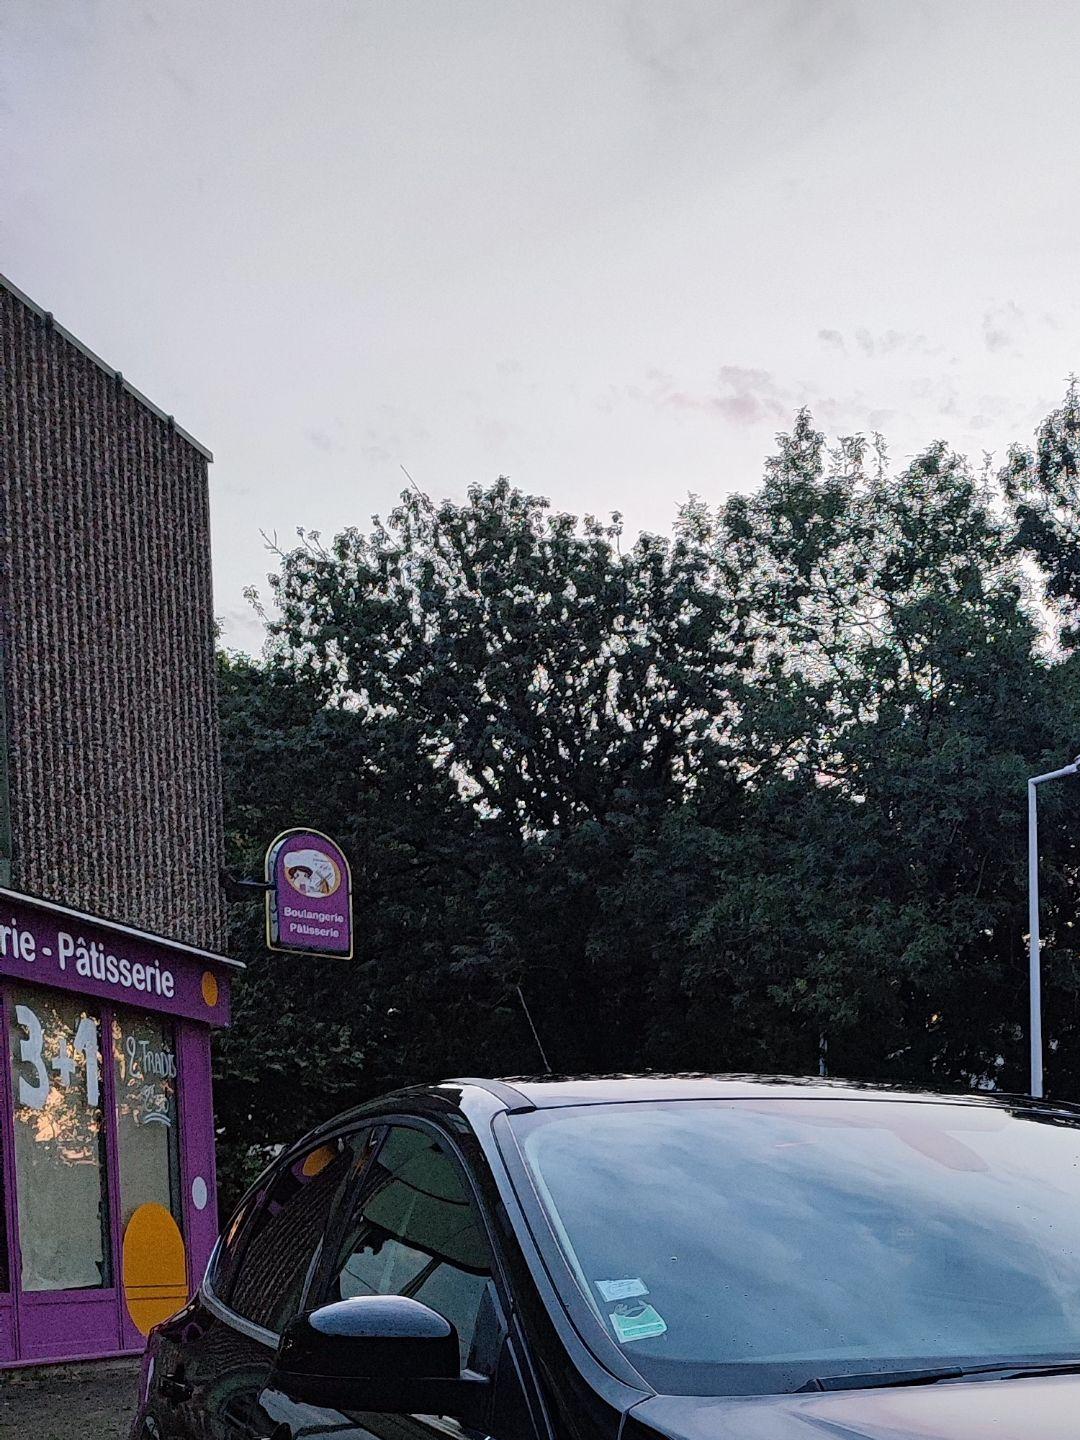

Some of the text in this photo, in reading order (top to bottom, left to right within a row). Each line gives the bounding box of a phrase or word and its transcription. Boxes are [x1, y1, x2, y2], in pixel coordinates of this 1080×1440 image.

[283, 906, 344, 923] Boulangerie
[289, 922, 339, 938] Pâtisserie
[0, 917, 36, 962] rie
[57, 931, 175, 998] Pâtisserie
